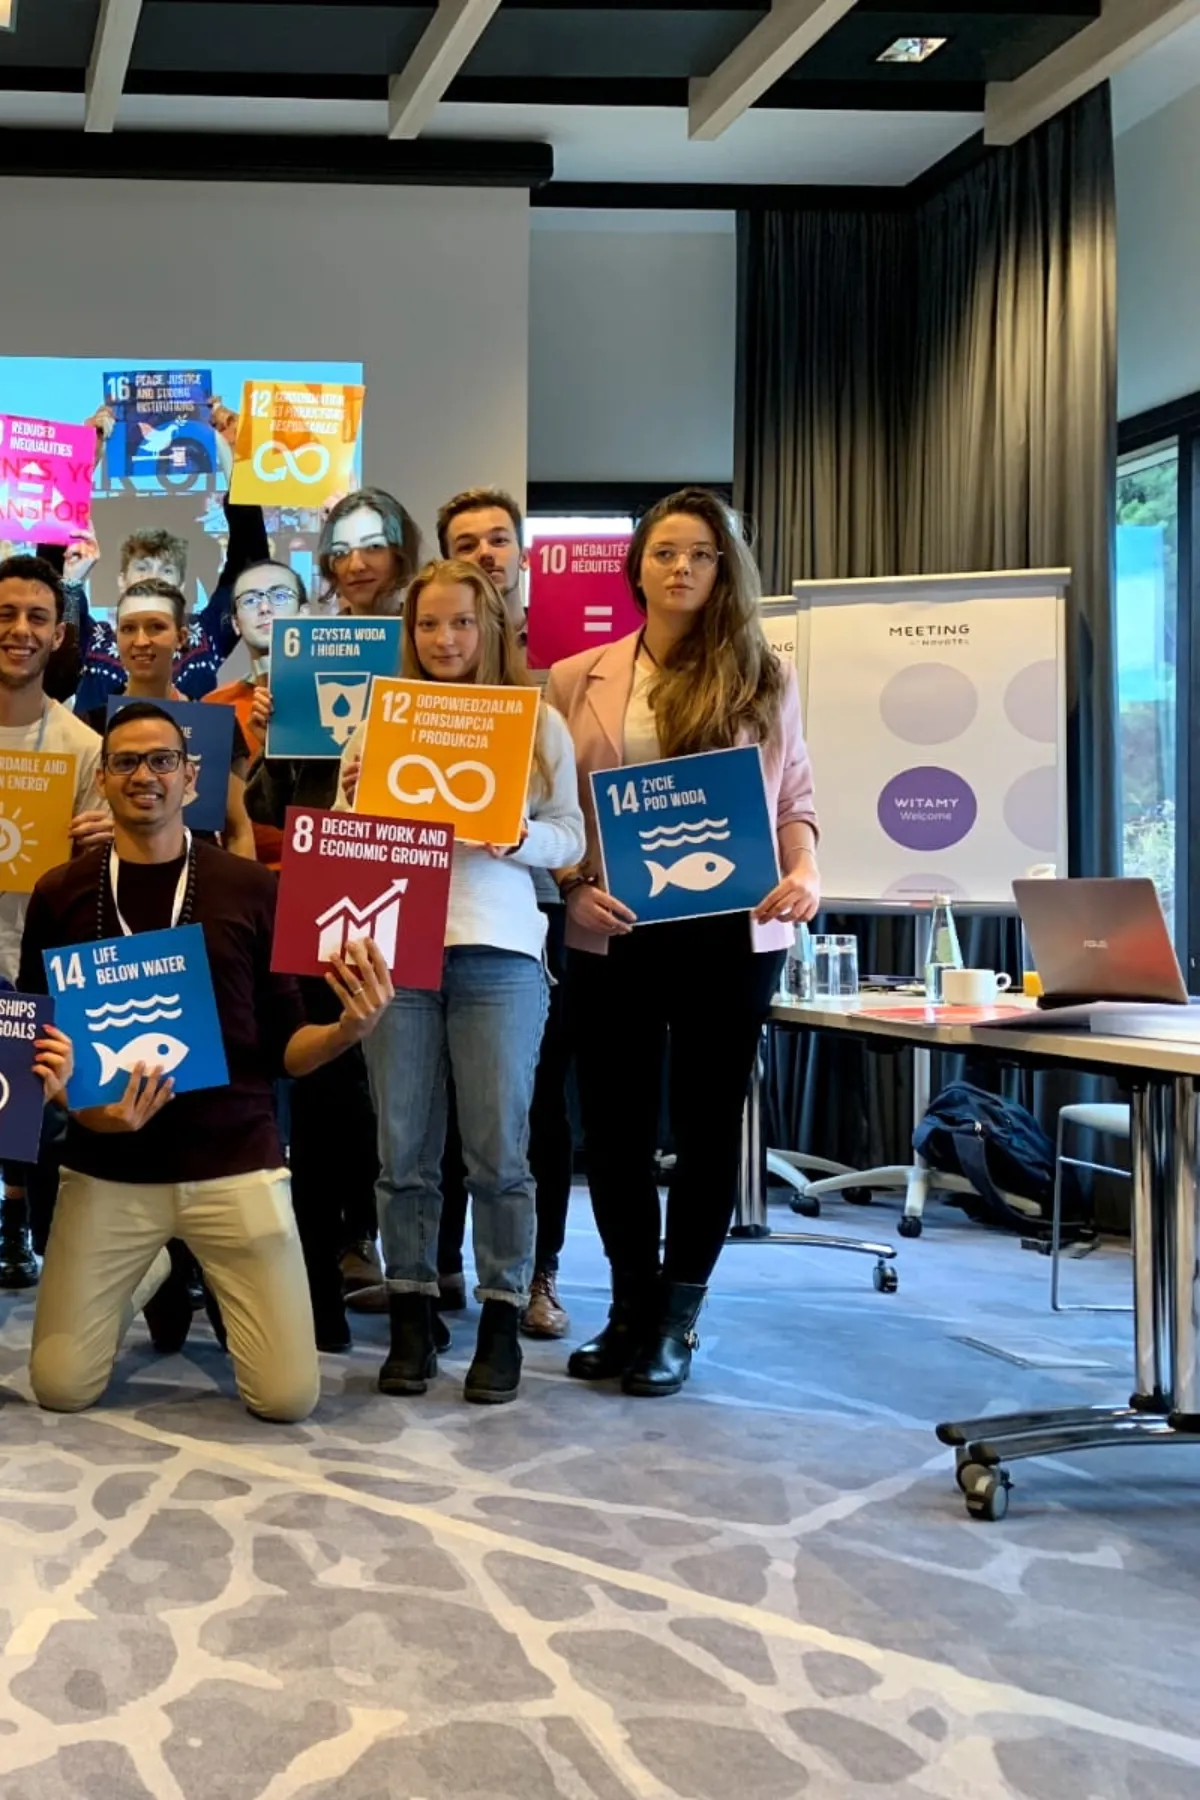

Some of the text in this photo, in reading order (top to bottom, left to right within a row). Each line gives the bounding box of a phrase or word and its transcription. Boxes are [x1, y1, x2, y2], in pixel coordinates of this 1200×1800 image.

[108, 376, 130, 401] 16
[168, 373, 202, 385] JUSTICE
[137, 388, 154, 400] AND
[251, 389, 271, 417] 12
[11, 421, 55, 438] REDUCED
[10, 437, 73, 457] INEQUALITIES
[540, 544, 566, 575] 10
[571, 557, 621, 573] RÉDUITES
[311, 627, 386, 642] CZYSTA WODA
[889, 623, 970, 637] MEETING
[283, 628, 301, 657] 6
[318, 643, 361, 658] HIGIENA
[381, 690, 411, 725] 12
[415, 694, 523, 715] ODPOWIEDZIALNA
[414, 713, 494, 732] KONSUMPCJA
[418, 731, 489, 749] PRODUKCJA
[43, 759, 67, 775] AND
[7, 775, 50, 792] ENERGY
[642, 773, 675, 794] ŻYCIE
[607, 780, 641, 816] 14
[643, 791, 669, 812] POD
[894, 798, 959, 808] WITAMY
[900, 811, 952, 821] Welcome
[292, 815, 314, 853] 8
[321, 818, 447, 847] DECENT WORK AND
[319, 839, 449, 868] ECONOMIC GROWTH
[93, 946, 118, 965] LIFE
[49, 952, 86, 992] 14
[95, 956, 186, 985] BELOW WATER
